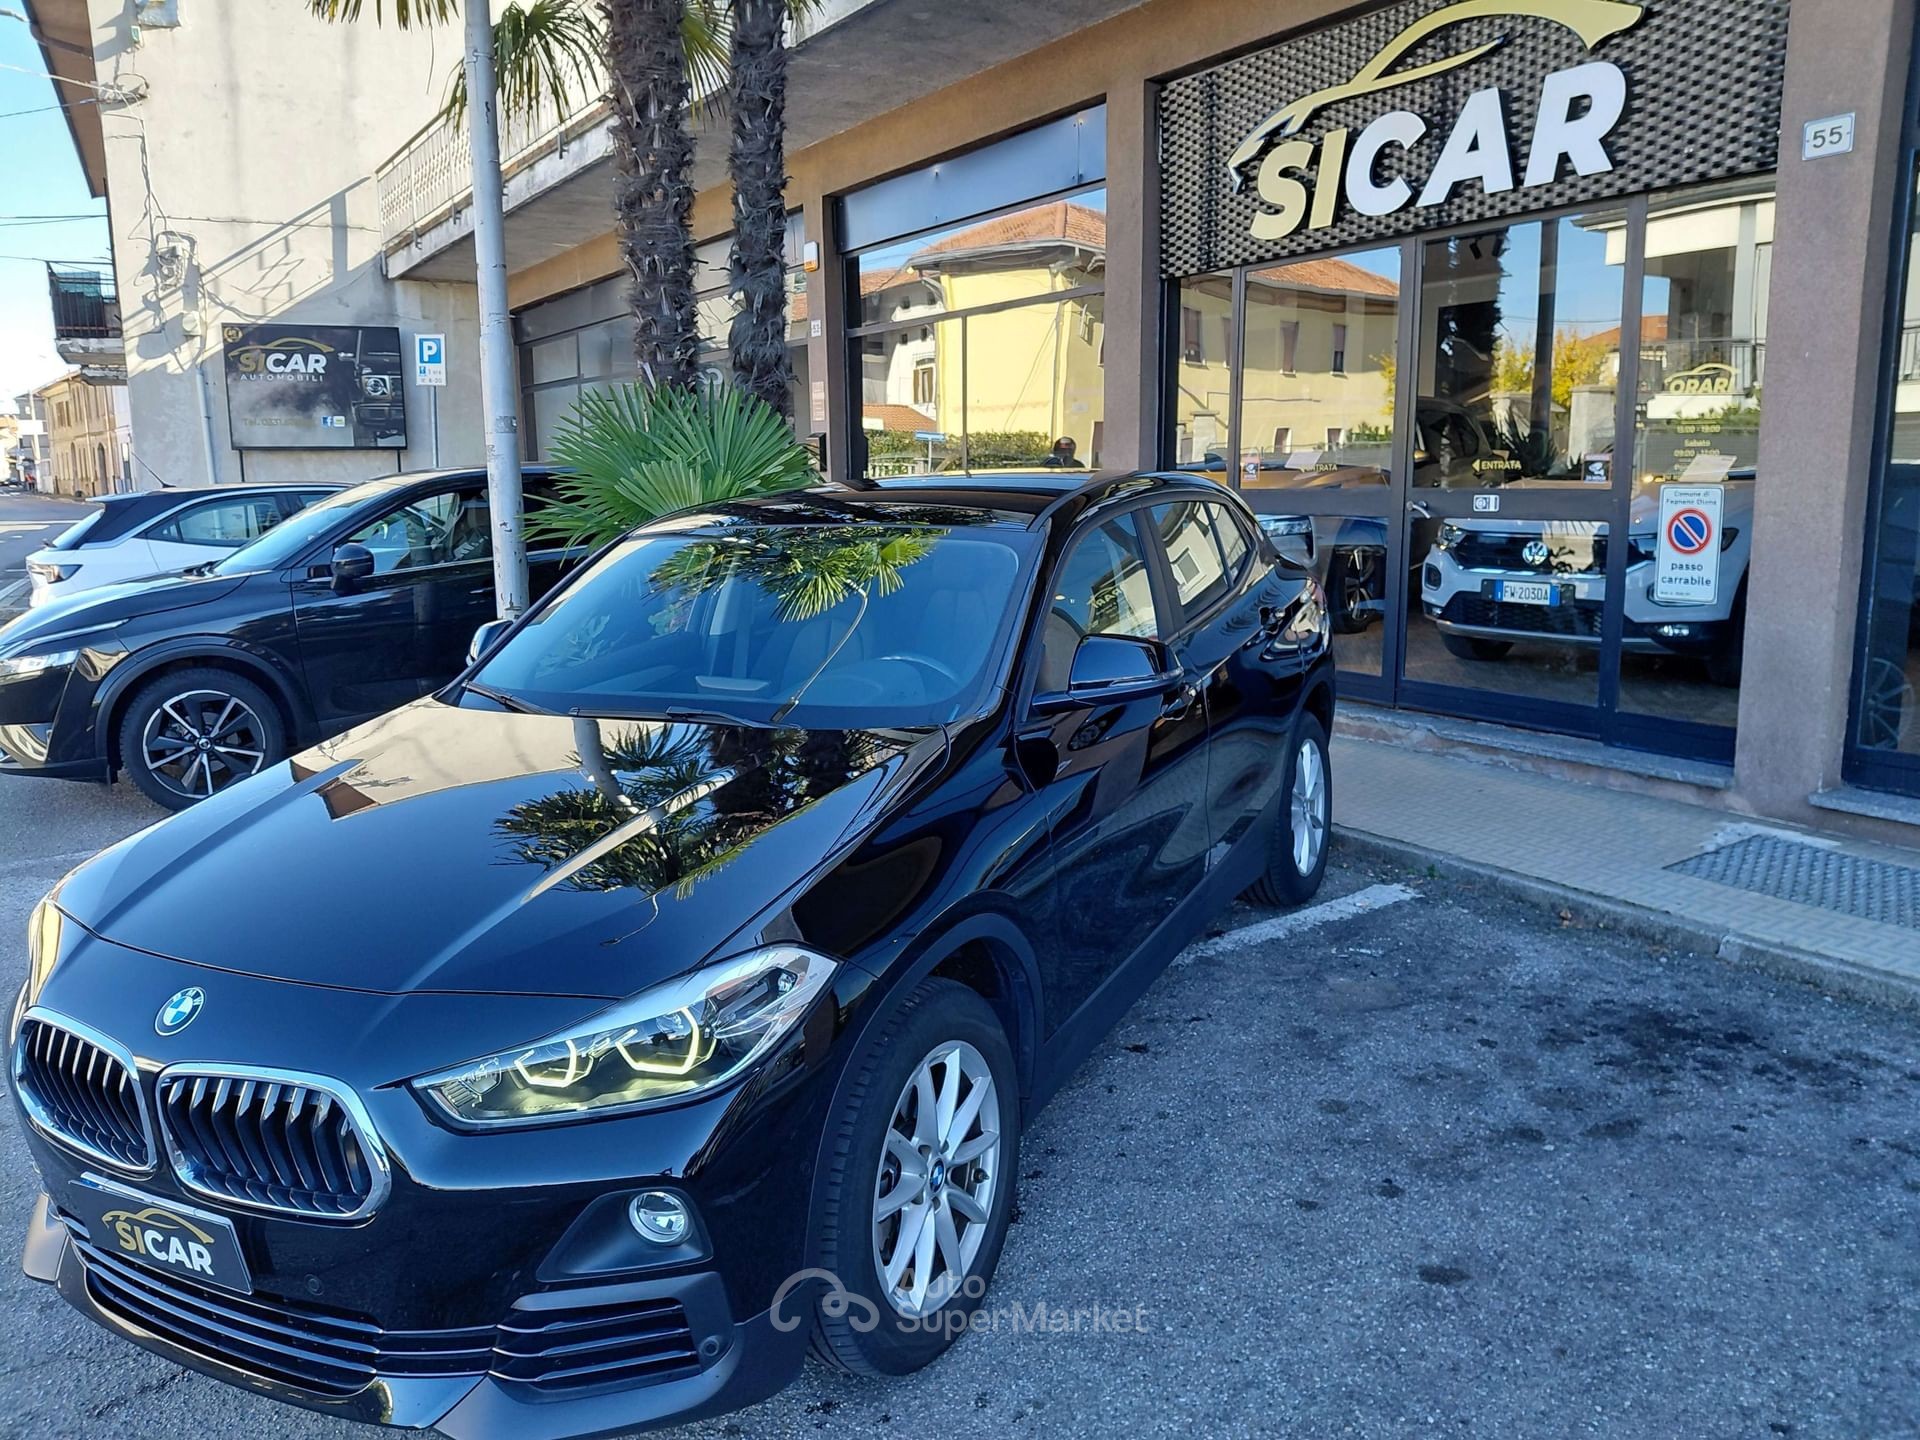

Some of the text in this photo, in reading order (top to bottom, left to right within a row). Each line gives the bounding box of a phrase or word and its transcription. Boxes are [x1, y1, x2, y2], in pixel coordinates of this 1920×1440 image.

[1811, 126, 1843, 148] 55
[1250, 61, 1626, 240] SICAR
[423, 341, 438, 362] P
[239, 352, 327, 373] SICAR
[1481, 460, 1521, 470] ENTRATA
[1671, 563, 1704, 572] passo
[1661, 576, 1712, 587] carrabile
[115, 1218, 215, 1276] SICAR
